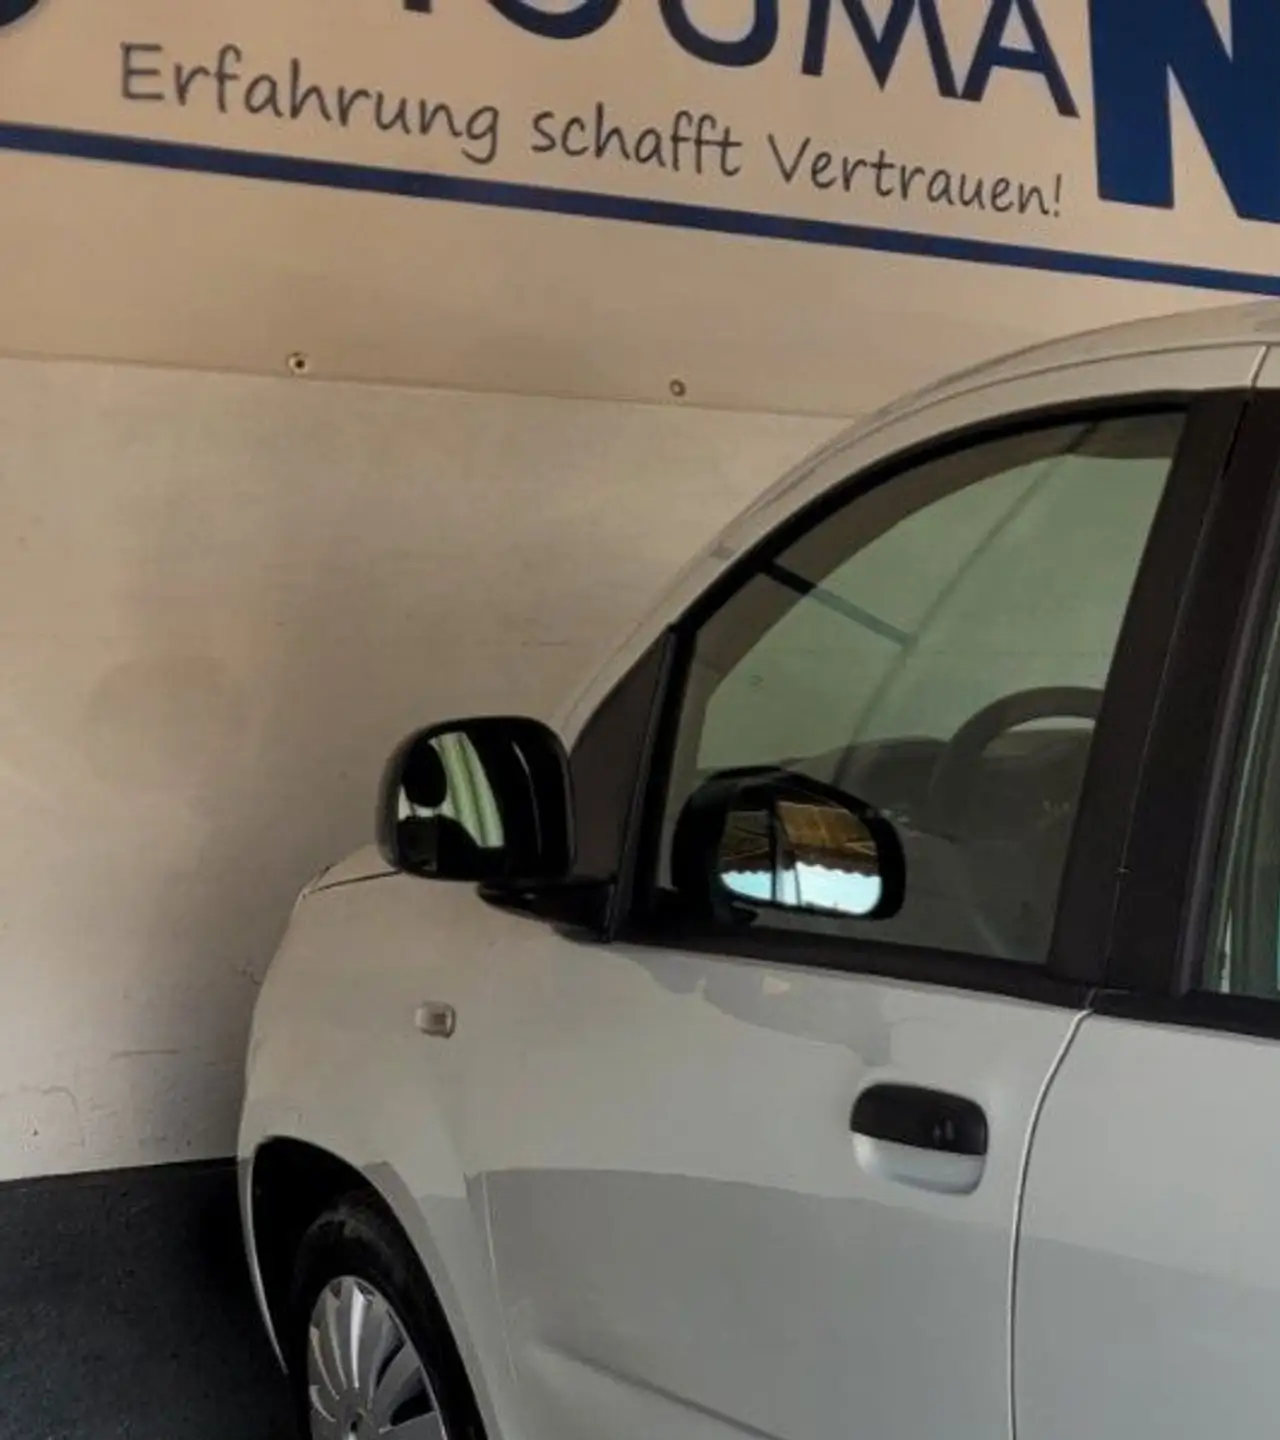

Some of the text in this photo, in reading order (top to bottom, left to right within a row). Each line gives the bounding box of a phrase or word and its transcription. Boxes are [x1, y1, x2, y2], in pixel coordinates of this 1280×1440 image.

[119, 41, 1062, 217] Erfahrung schafft Vertrauen!
